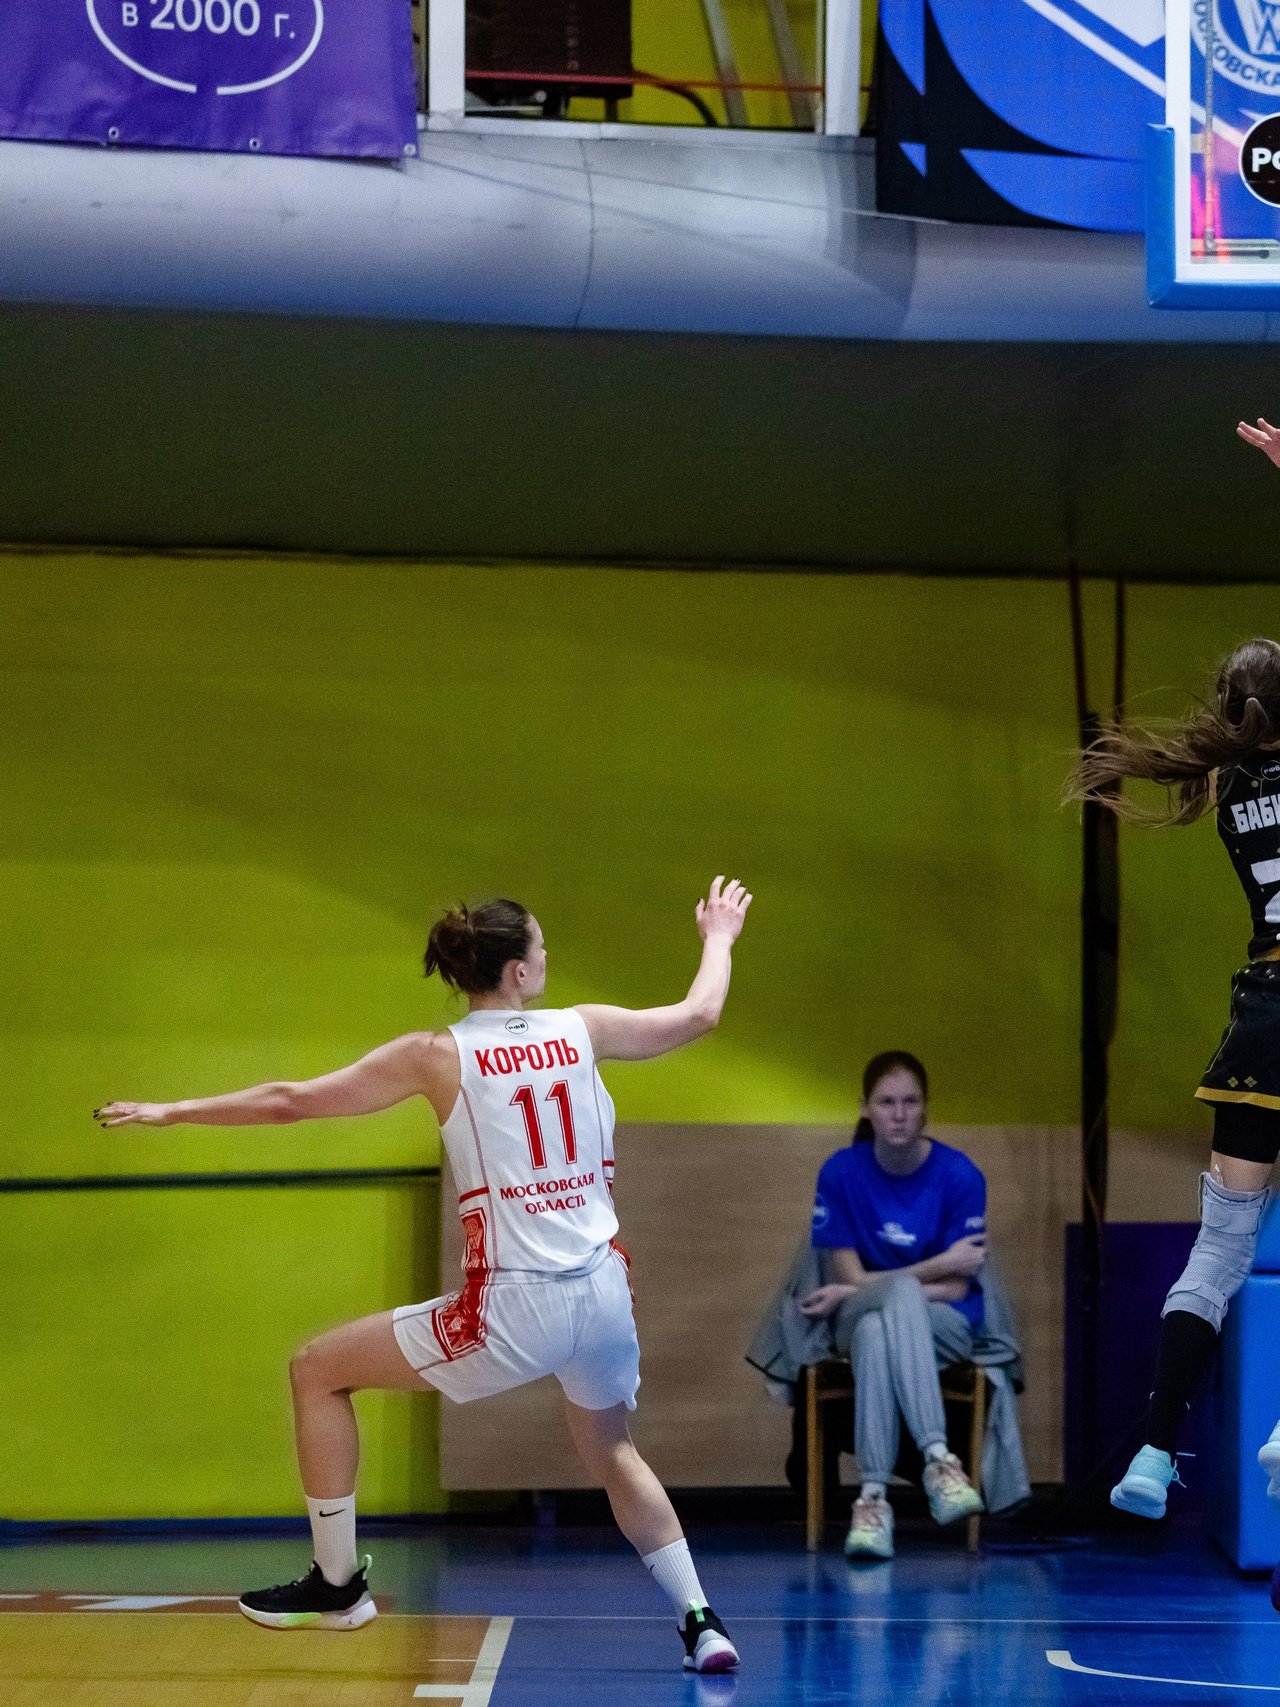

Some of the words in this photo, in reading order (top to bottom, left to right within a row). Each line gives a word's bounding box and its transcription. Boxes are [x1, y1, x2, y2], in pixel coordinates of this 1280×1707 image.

[150, 0, 261, 36] 2000
[274, 13, 296, 39] г.
[475, 1038, 580, 1078] КОРОЛЬ
[508, 1079, 578, 1171] 11
[499, 1172, 595, 1201] МОСКОВСКАЯ
[525, 1194, 587, 1215] ОБЛАСТЬ
